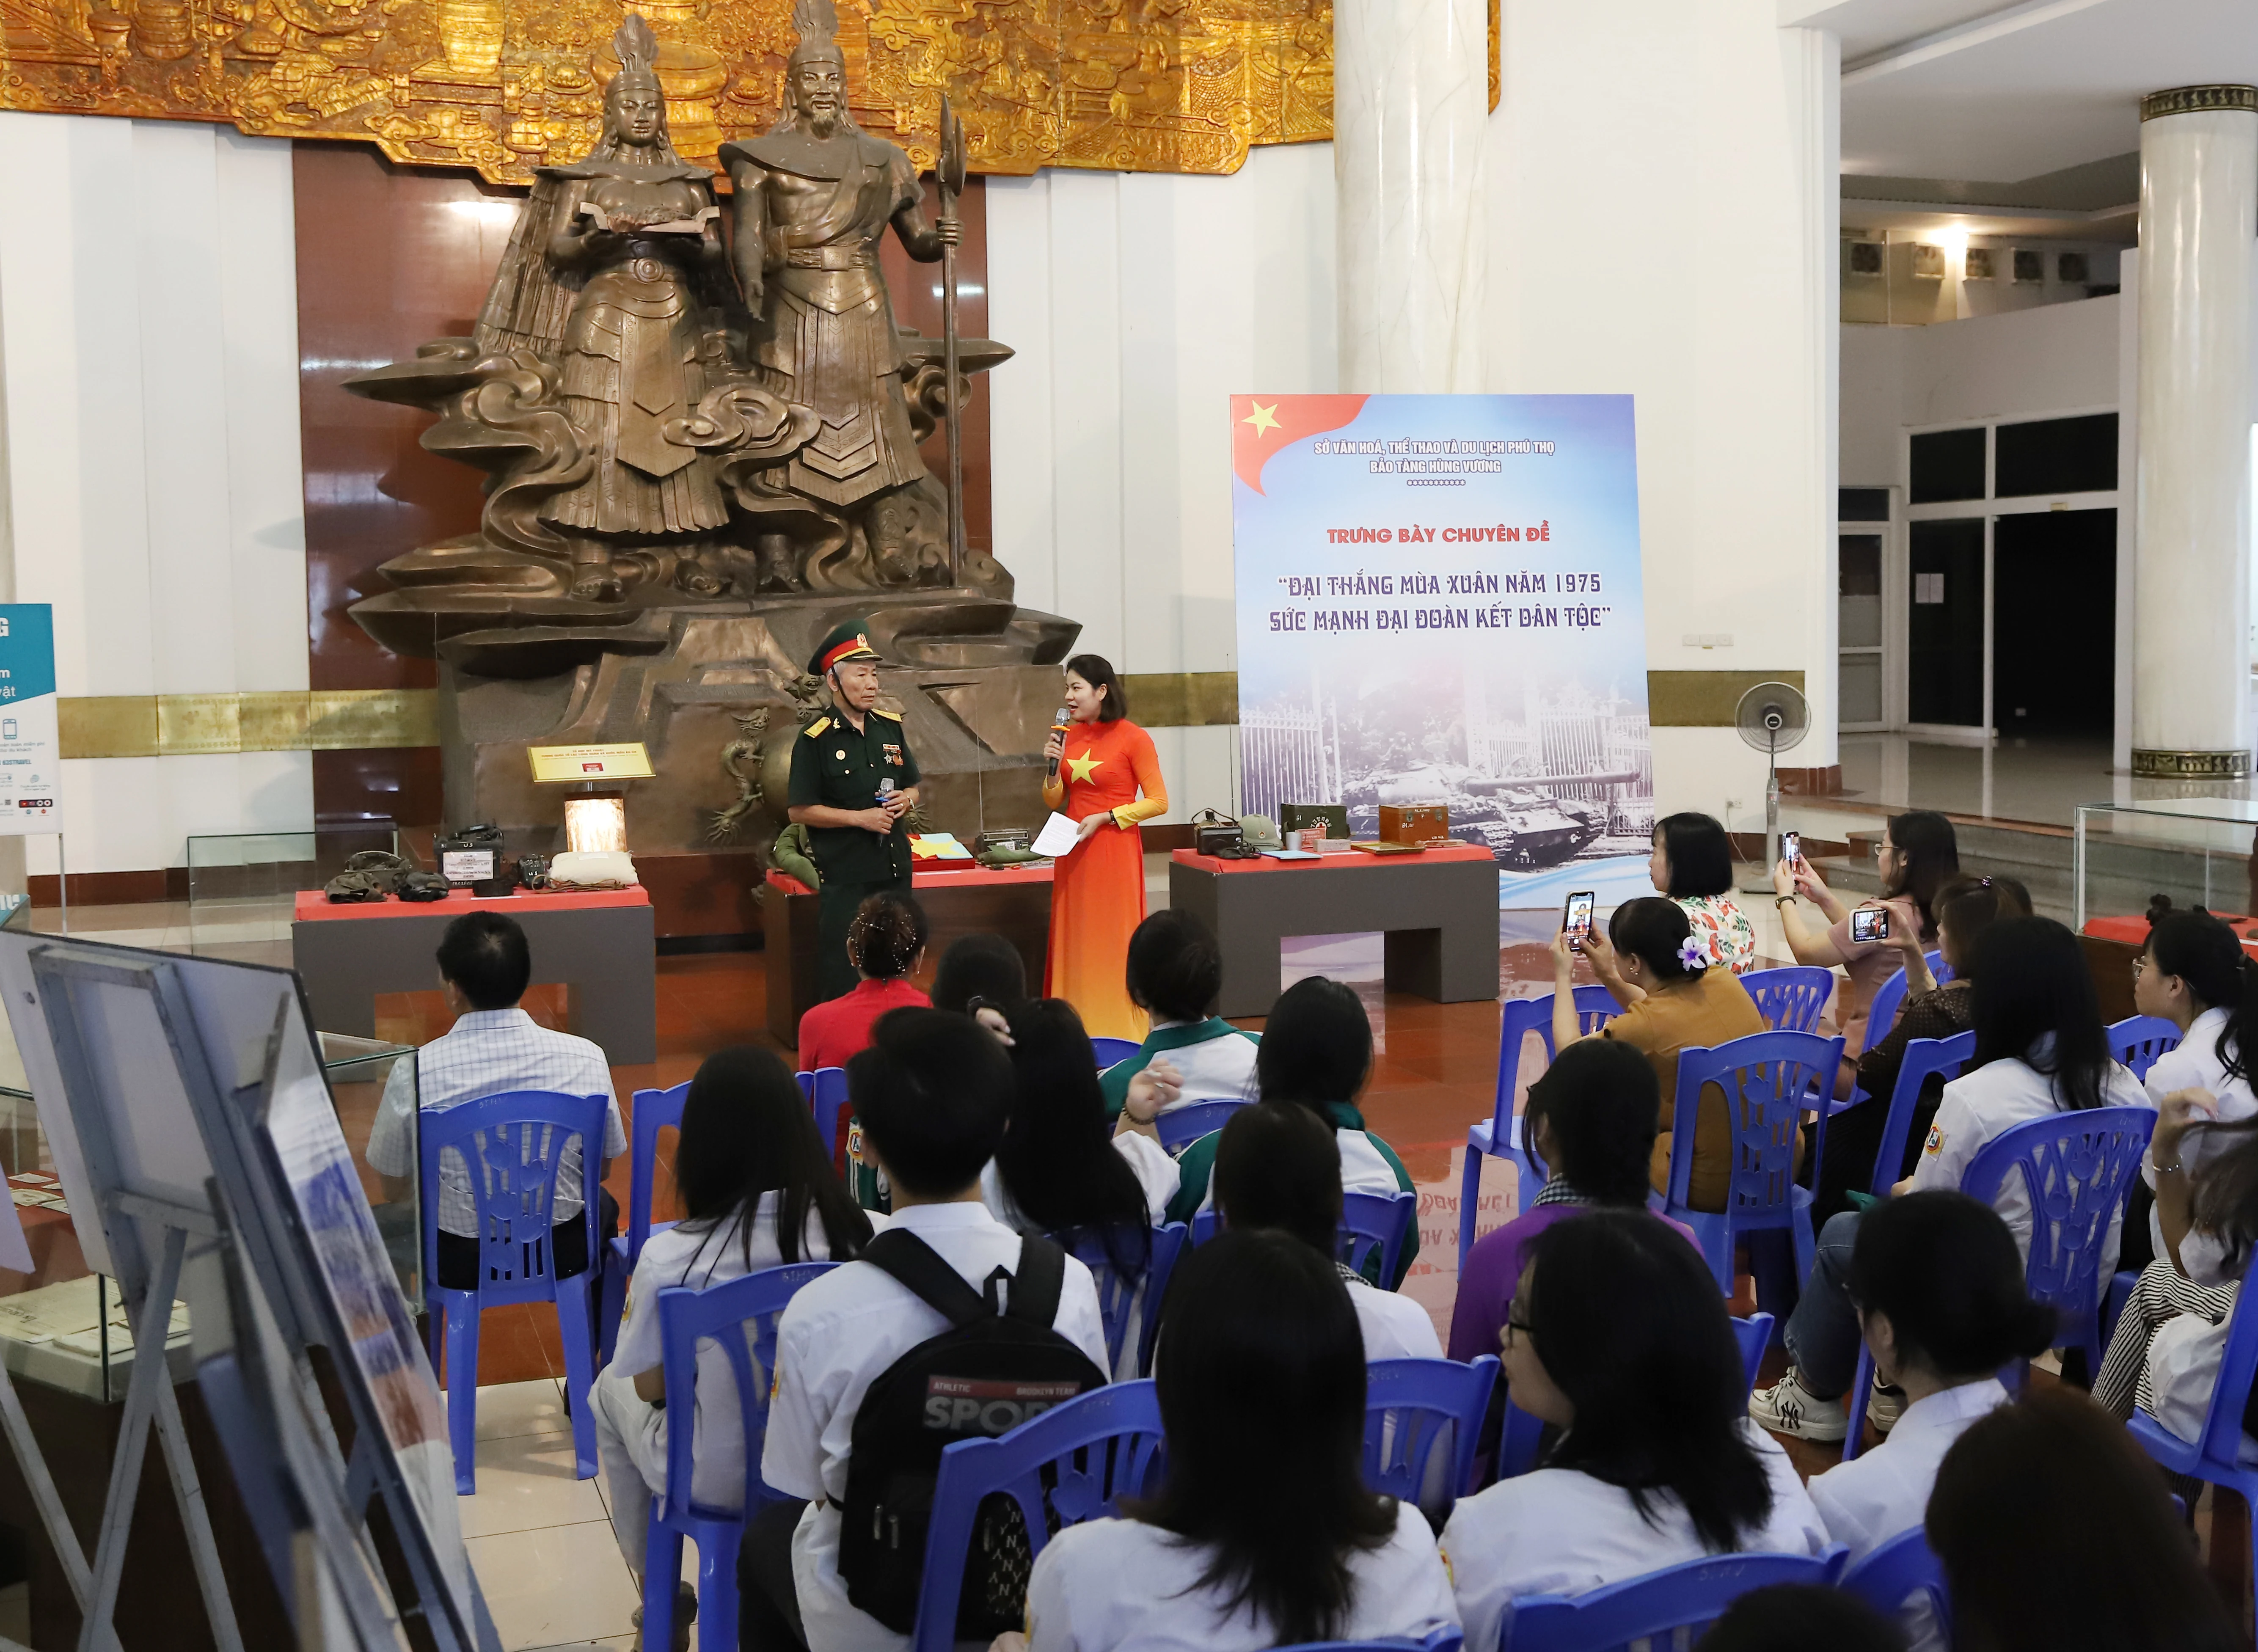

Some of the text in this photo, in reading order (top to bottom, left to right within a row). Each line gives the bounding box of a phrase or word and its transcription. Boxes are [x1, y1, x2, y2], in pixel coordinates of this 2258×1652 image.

[1314, 437, 1555, 456] SỞ VĂN HOÁ, THỂ THAO VÀ DU LỊCH PHÚ THỌ
[1370, 457, 1501, 474] BẢO TÀNG HÙNG VƯƠNG
[1327, 520, 1550, 544] TRƯNG BÀY CHUYÊN ĐỀ
[1327, 568, 1393, 595] THẮNG
[1400, 571, 1441, 595] MÙA
[1446, 570, 1498, 594] XUÂN
[1506, 570, 1547, 593] NĂM
[1556, 573, 1601, 592] 1975
[1270, 606, 1306, 632] SỨC
[1313, 610, 1369, 635] MẠNH
[1376, 609, 1408, 634] ĐẠI
[1415, 604, 1469, 629] ĐOÀN
[1476, 601, 1512, 628] KẾT
[1519, 603, 1558, 628] DÂN
[933, 1381, 971, 1393] ATHLETIC
[1016, 1387, 1076, 1396] BROOKLYN TEAM
